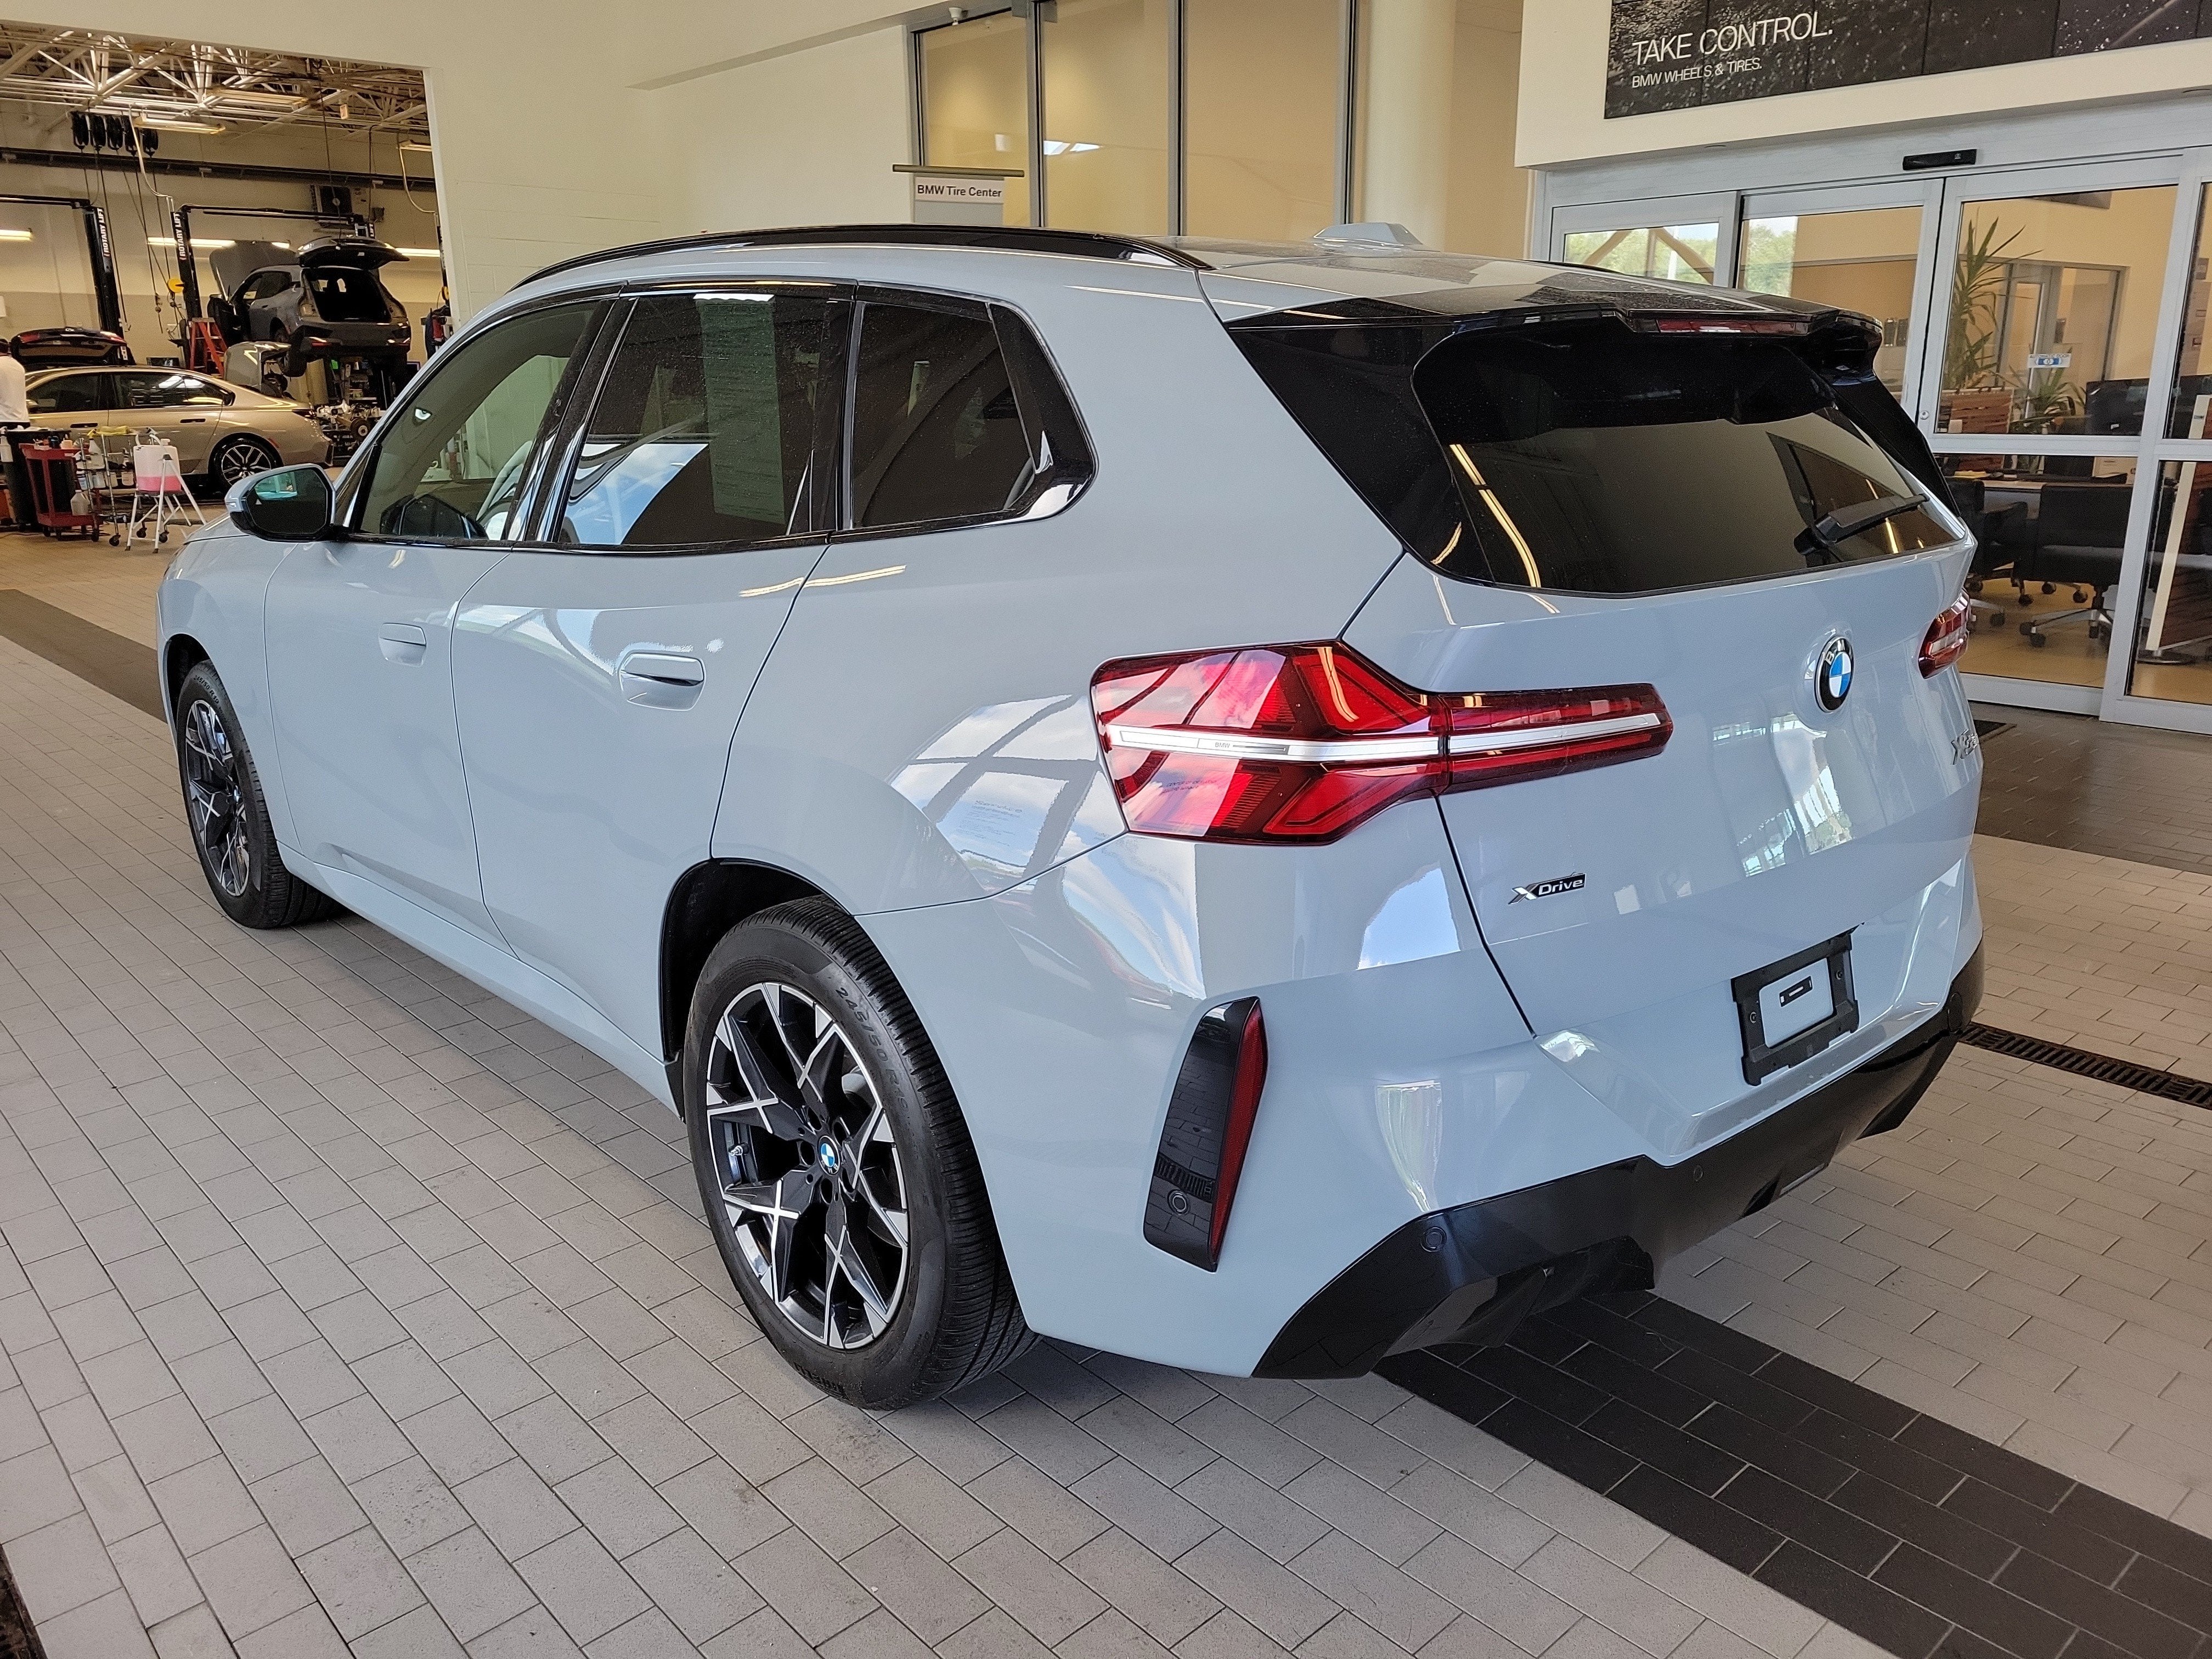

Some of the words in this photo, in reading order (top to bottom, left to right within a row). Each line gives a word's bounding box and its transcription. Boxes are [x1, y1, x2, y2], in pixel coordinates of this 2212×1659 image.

[1632, 33, 1694, 65] TAKE
[1700, 10, 1833, 54] CONTROL.
[1632, 72, 1663, 88] BMW
[1664, 64, 1712, 83] WHEELS
[1715, 63, 1724, 76] &
[1727, 58, 1762, 74] TIRES.
[917, 184, 945, 195] BMW
[946, 186, 966, 196] Tire
[969, 187, 1002, 197] Center
[173, 213, 182, 227] LIFT
[99, 224, 109, 253] ROTARY
[175, 229, 186, 256] ROTARY
[836, 987, 889, 1062] 245/50
